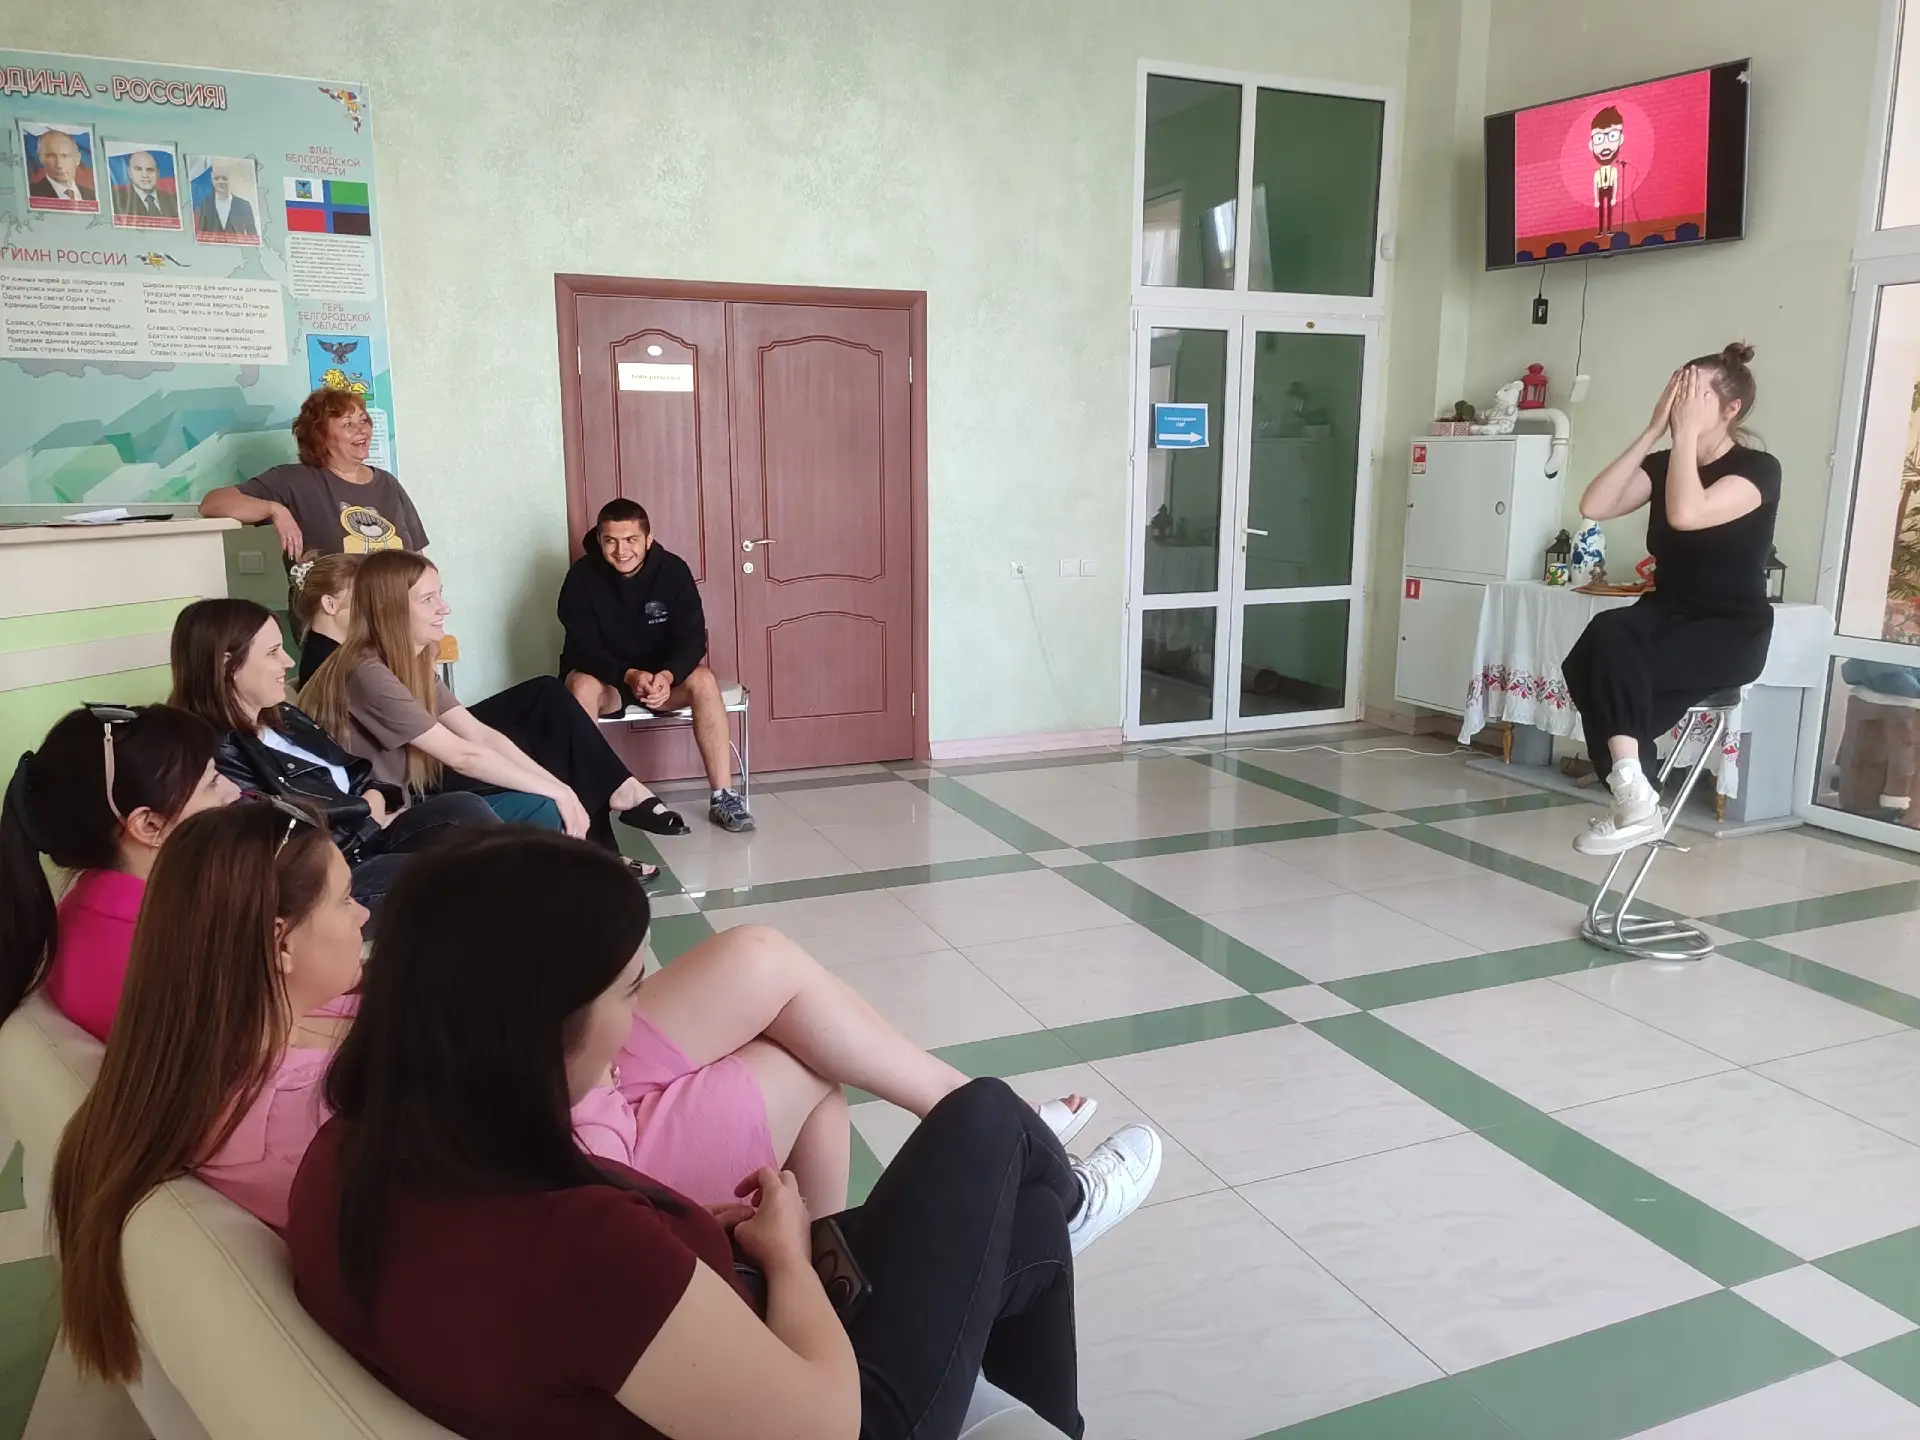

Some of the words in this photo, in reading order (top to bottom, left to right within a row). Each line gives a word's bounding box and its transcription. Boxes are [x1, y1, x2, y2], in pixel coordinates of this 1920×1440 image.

[95, 84, 107, 92] -
[112, 76, 228, 110] РОССИЯ!
[308, 146, 334, 154] ФЛАГ
[285, 153, 361, 168] БЕЛГОРОДСКОЙ
[300, 164, 347, 177] ОБЛАСТИ
[0, 247, 52, 263] ГИМН
[56, 249, 128, 266] РОССИИ
[322, 303, 344, 312] ГЕРБ
[299, 311, 372, 323] БЕЛГОРОДСКОЙ
[312, 321, 357, 331] ОБЛАСТИ
